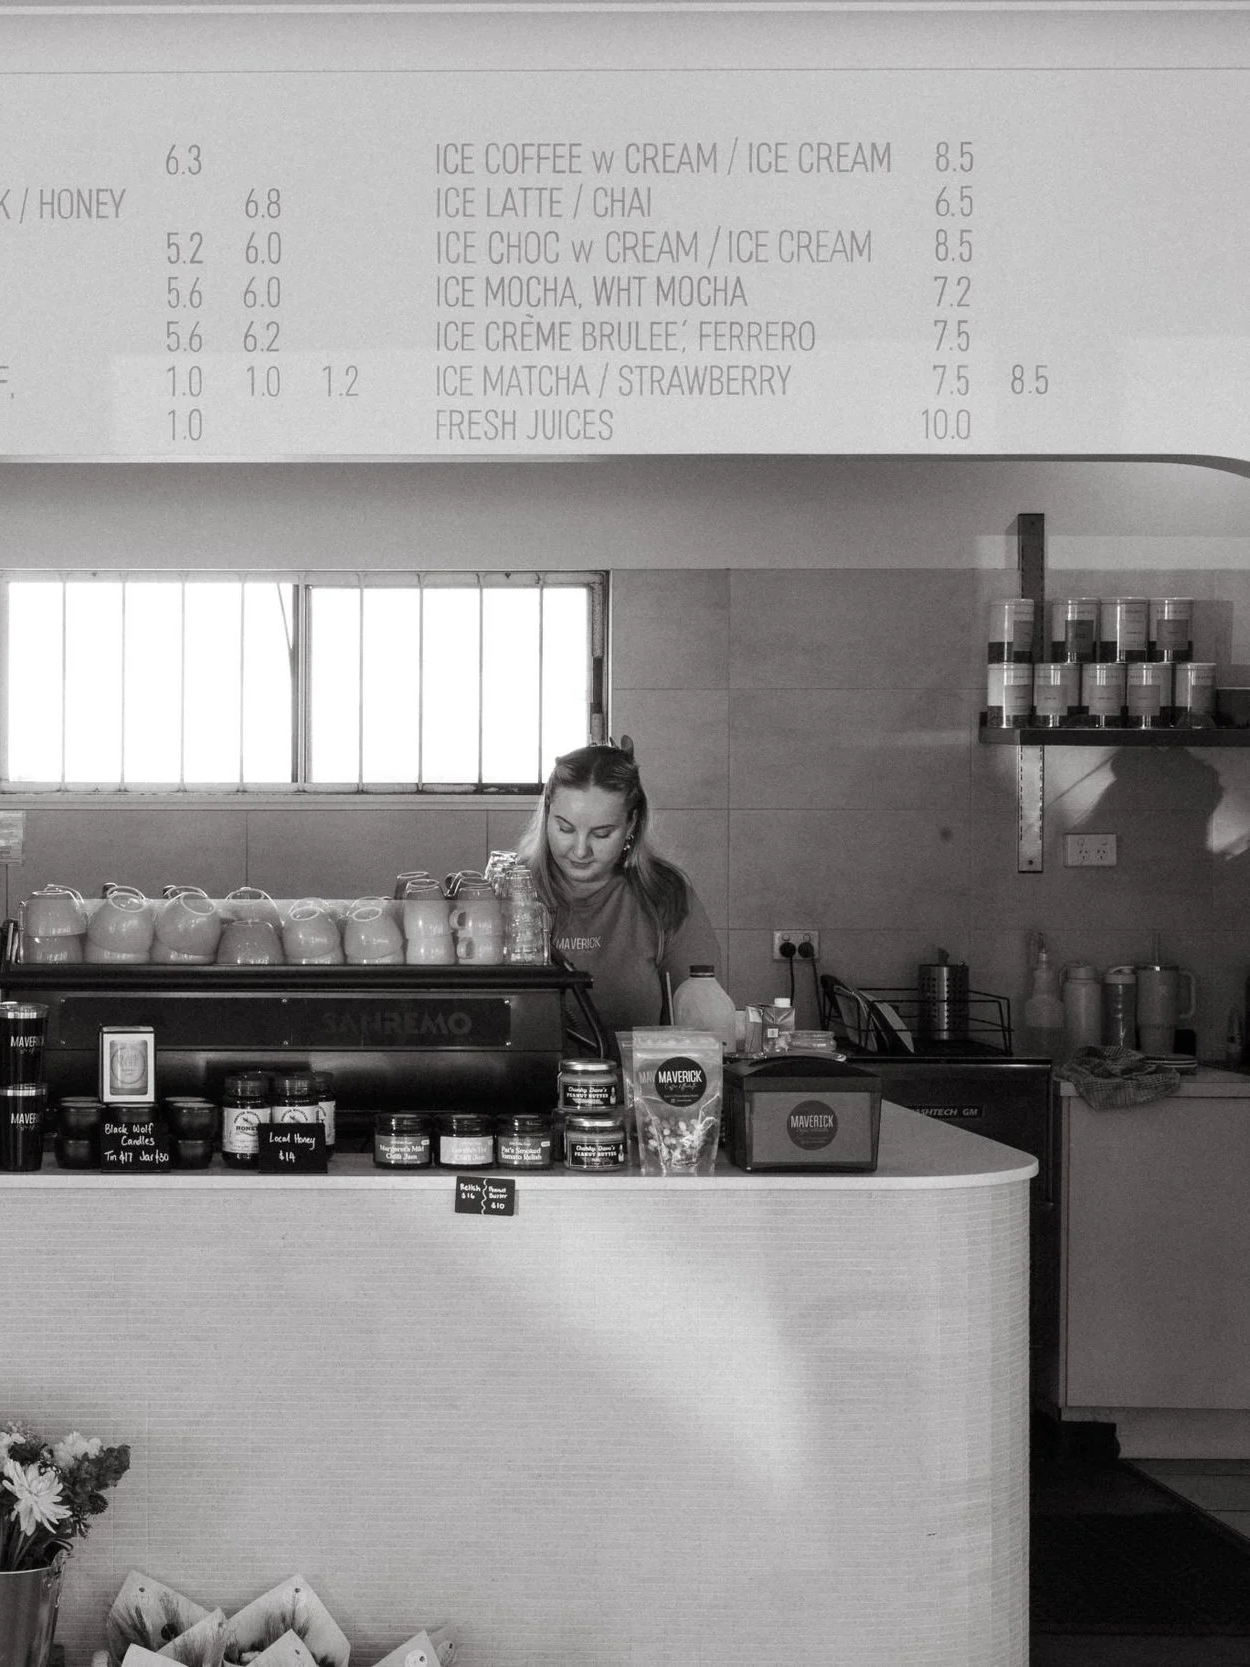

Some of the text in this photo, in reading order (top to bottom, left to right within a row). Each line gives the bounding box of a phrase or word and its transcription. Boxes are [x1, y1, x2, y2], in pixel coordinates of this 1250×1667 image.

[435, 141, 892, 176] ICE COFFEE CREAM ICE CREAM
[39, 187, 127, 220] HONEY
[436, 186, 652, 219] ICE LATTE CHAI
[436, 229, 872, 266] ICE CHOC CREAM ICE CREAM
[436, 274, 749, 310] ICE MOCHA, WHT MOCHA
[435, 313, 816, 352] ICE CRÈME FERRERO
[436, 364, 792, 397] ICE MATCHA STRAWBERRY
[436, 408, 614, 441] FRESH JUICES
[556, 936, 602, 950] MAVERICK
[658, 1070, 702, 1083] MAVERICK
[104, 1123, 153, 1134] Black Wolf
[790, 1114, 834, 1128] MAVERICK
[121, 1135, 155, 1146] Candles
[269, 1132, 316, 1150] Local Honey
[139, 1151, 154, 1162] Jar
[279, 1150, 296, 1163] $14
